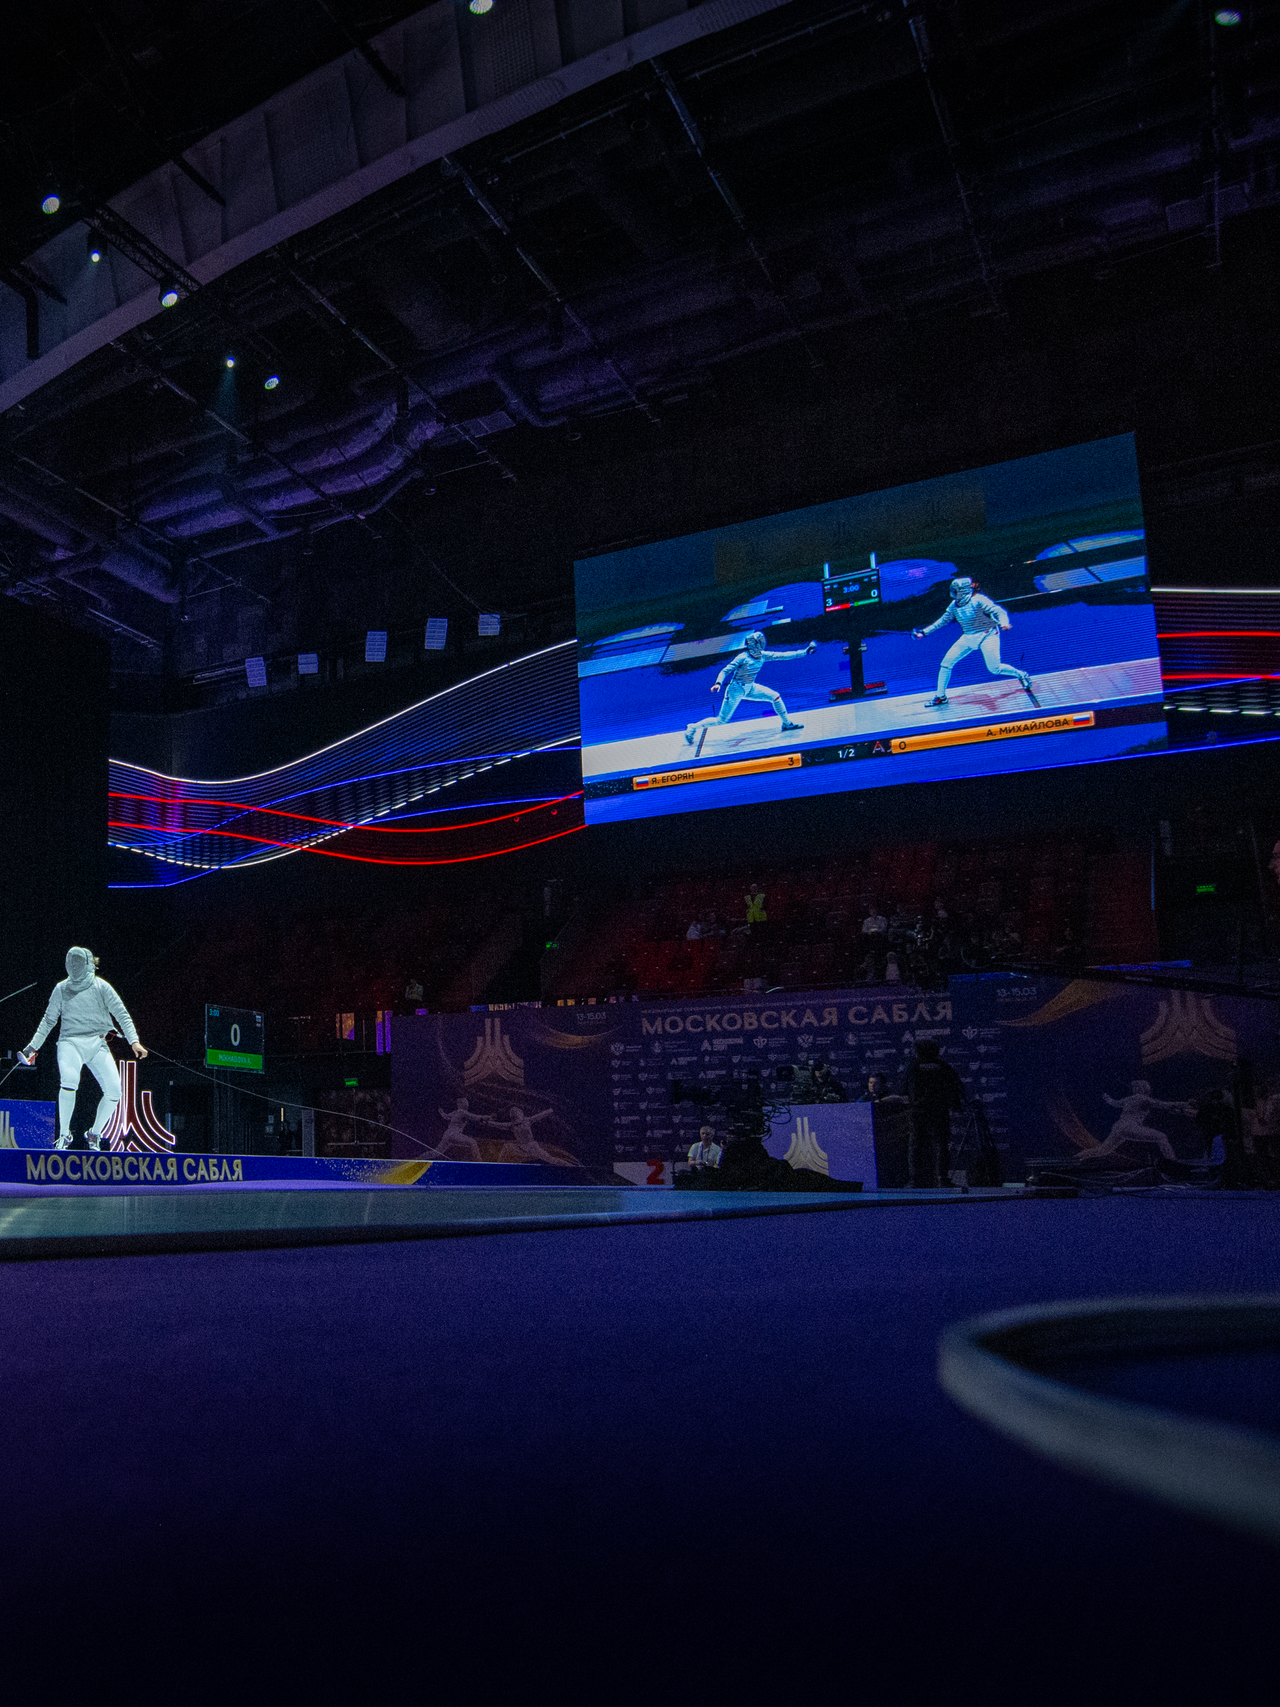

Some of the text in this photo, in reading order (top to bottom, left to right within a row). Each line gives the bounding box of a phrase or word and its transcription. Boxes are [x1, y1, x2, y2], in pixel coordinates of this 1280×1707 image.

[870, 588, 879, 598] 0
[825, 597, 833, 607] 3
[999, 717, 1070, 735] МИХАЙЛОВА
[837, 748, 855, 759] 1/2
[787, 757, 795, 766] 3
[661, 772, 695, 784] ЕГОРЯН
[641, 1007, 838, 1035] МОСКОВСКАЯ
[847, 1001, 953, 1025] САБЛЯ
[230, 1023, 240, 1047] 0
[25, 1154, 243, 1181] МОСКОВСКАЯ САБЛЯ
[647, 1160, 664, 1184] 2
